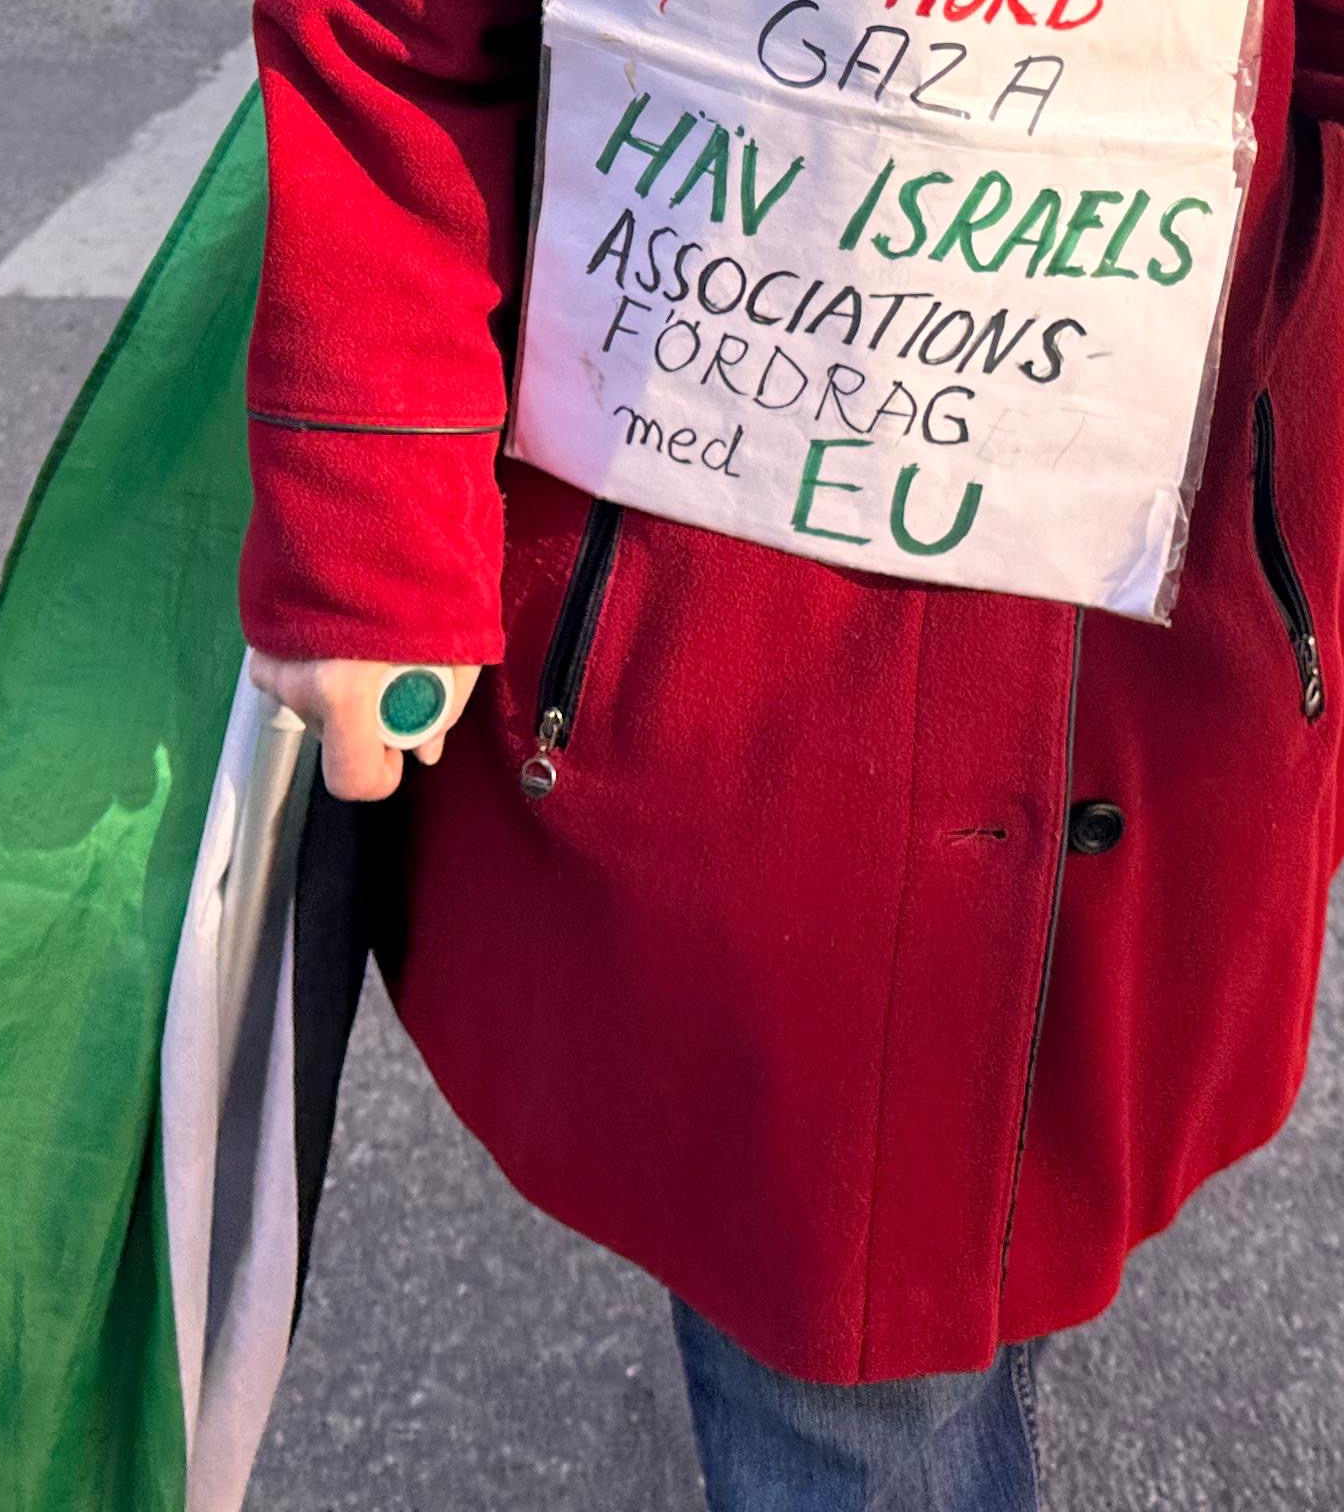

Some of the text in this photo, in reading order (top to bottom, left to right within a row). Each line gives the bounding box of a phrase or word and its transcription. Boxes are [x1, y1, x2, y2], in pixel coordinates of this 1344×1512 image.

[595, 91, 1213, 285] HÄV ISRAELS
[613, 404, 984, 556] med EU
